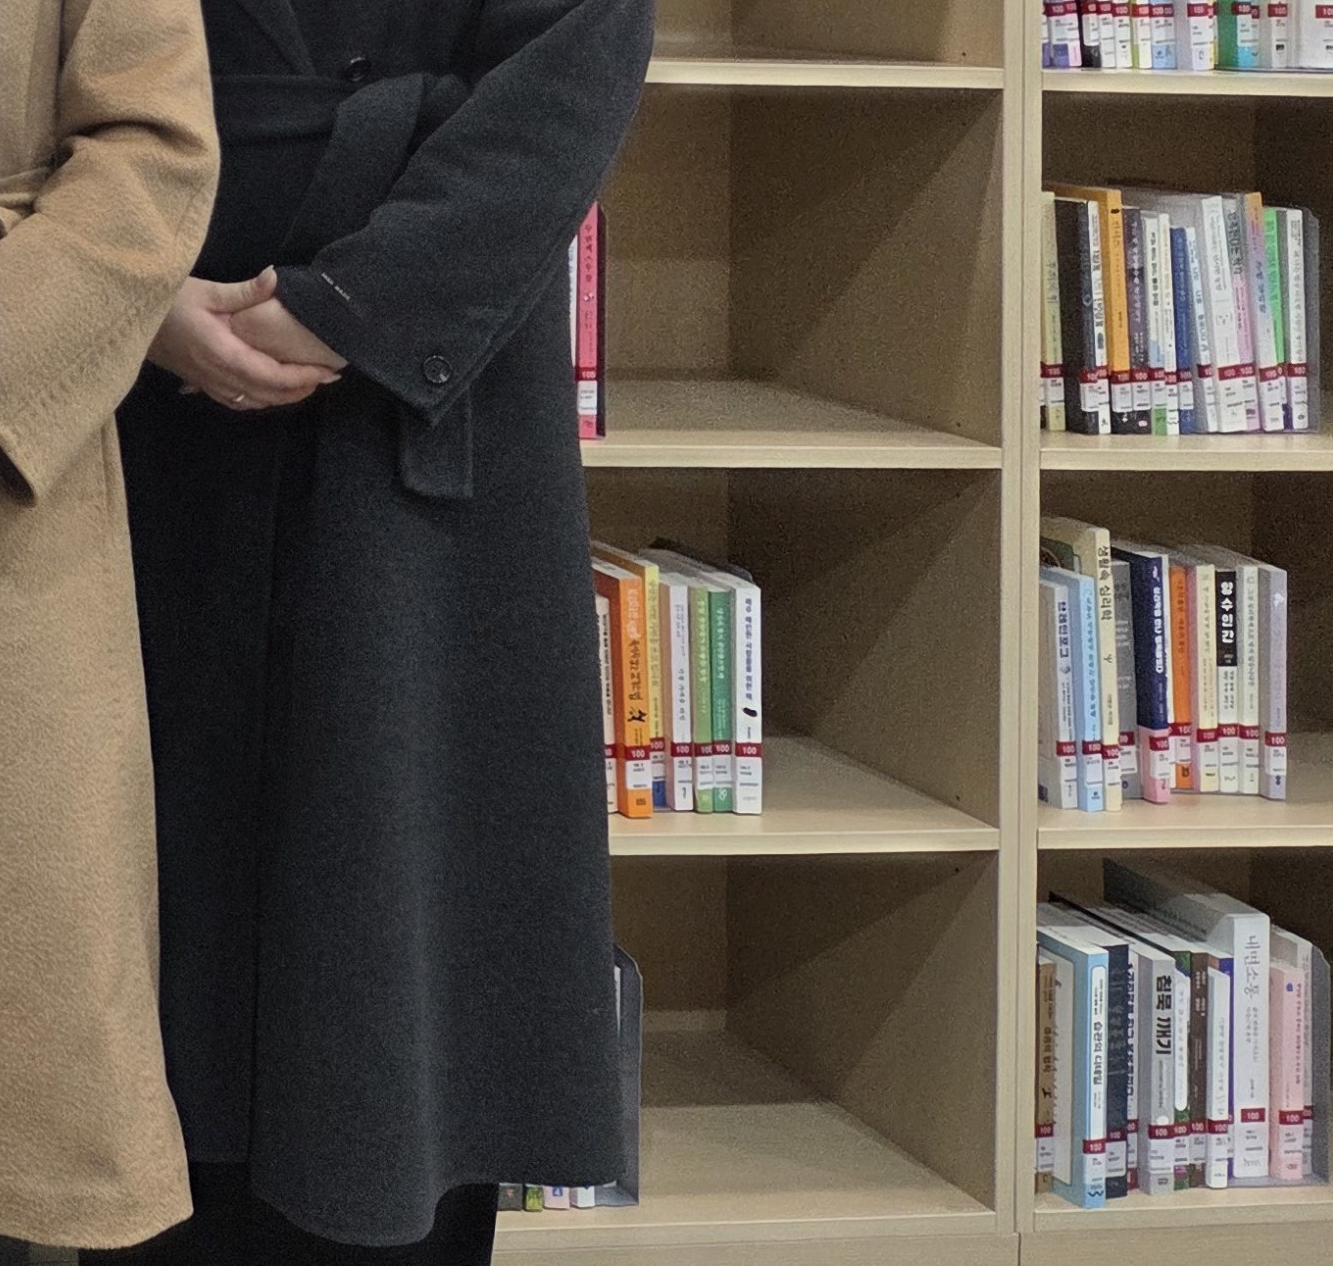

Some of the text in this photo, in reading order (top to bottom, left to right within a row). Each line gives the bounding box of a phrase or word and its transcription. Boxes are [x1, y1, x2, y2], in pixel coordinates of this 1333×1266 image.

[1097, 545, 1112, 621] 생활속 심리학
[1057, 601, 1070, 659] 브레인포그
[631, 750, 645, 758] 100
[1270, 737, 1284, 745] 100
[1155, 975, 1172, 1056] 침묵 깨기
